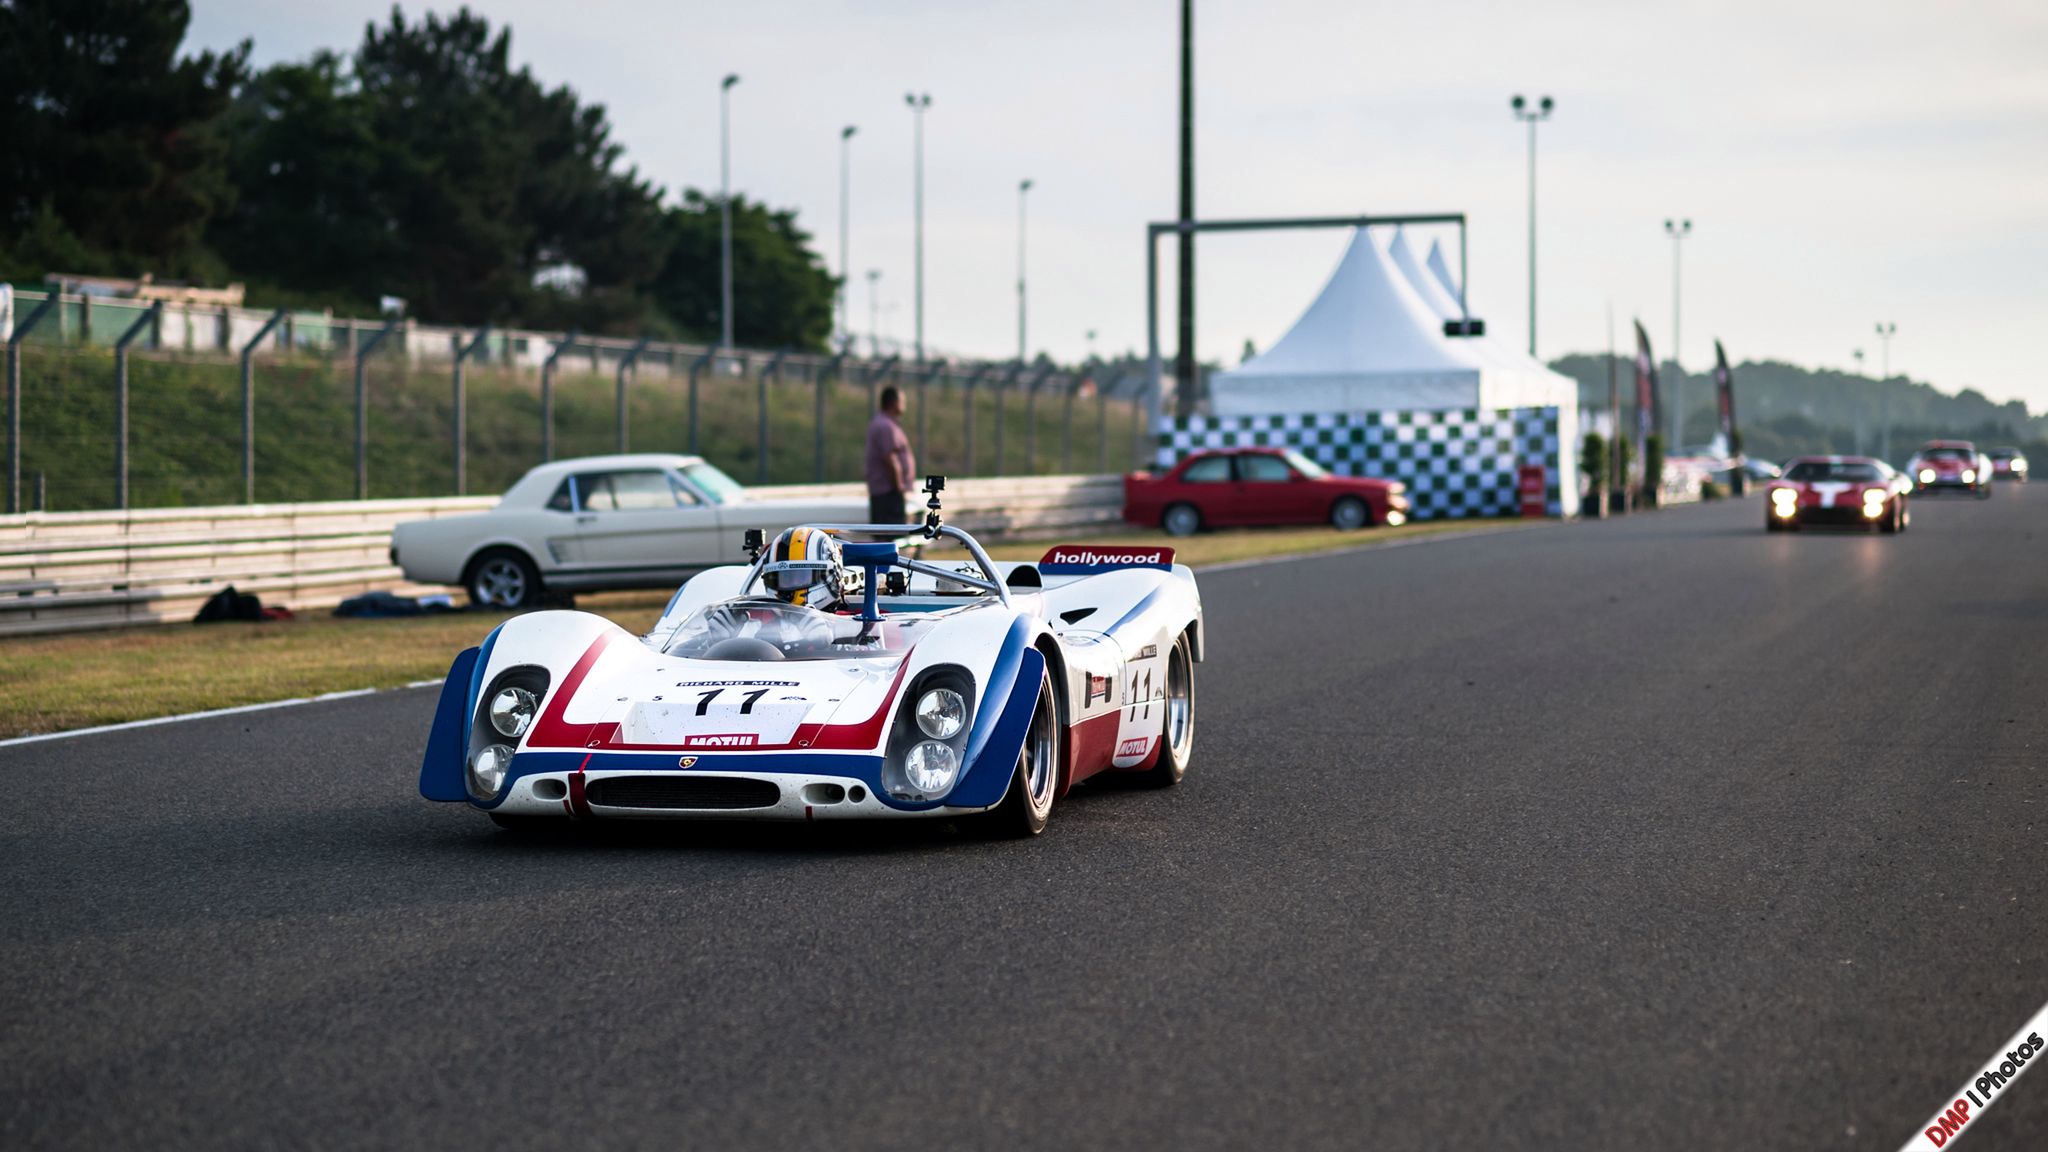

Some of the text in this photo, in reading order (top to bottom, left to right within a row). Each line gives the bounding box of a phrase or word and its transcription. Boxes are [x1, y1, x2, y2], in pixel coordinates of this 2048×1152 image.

[1054, 552, 1160, 566] hollywood
[695, 688, 770, 716] 11
[1130, 668, 1151, 722] 11
[1120, 740, 1147, 755] MOTUL
